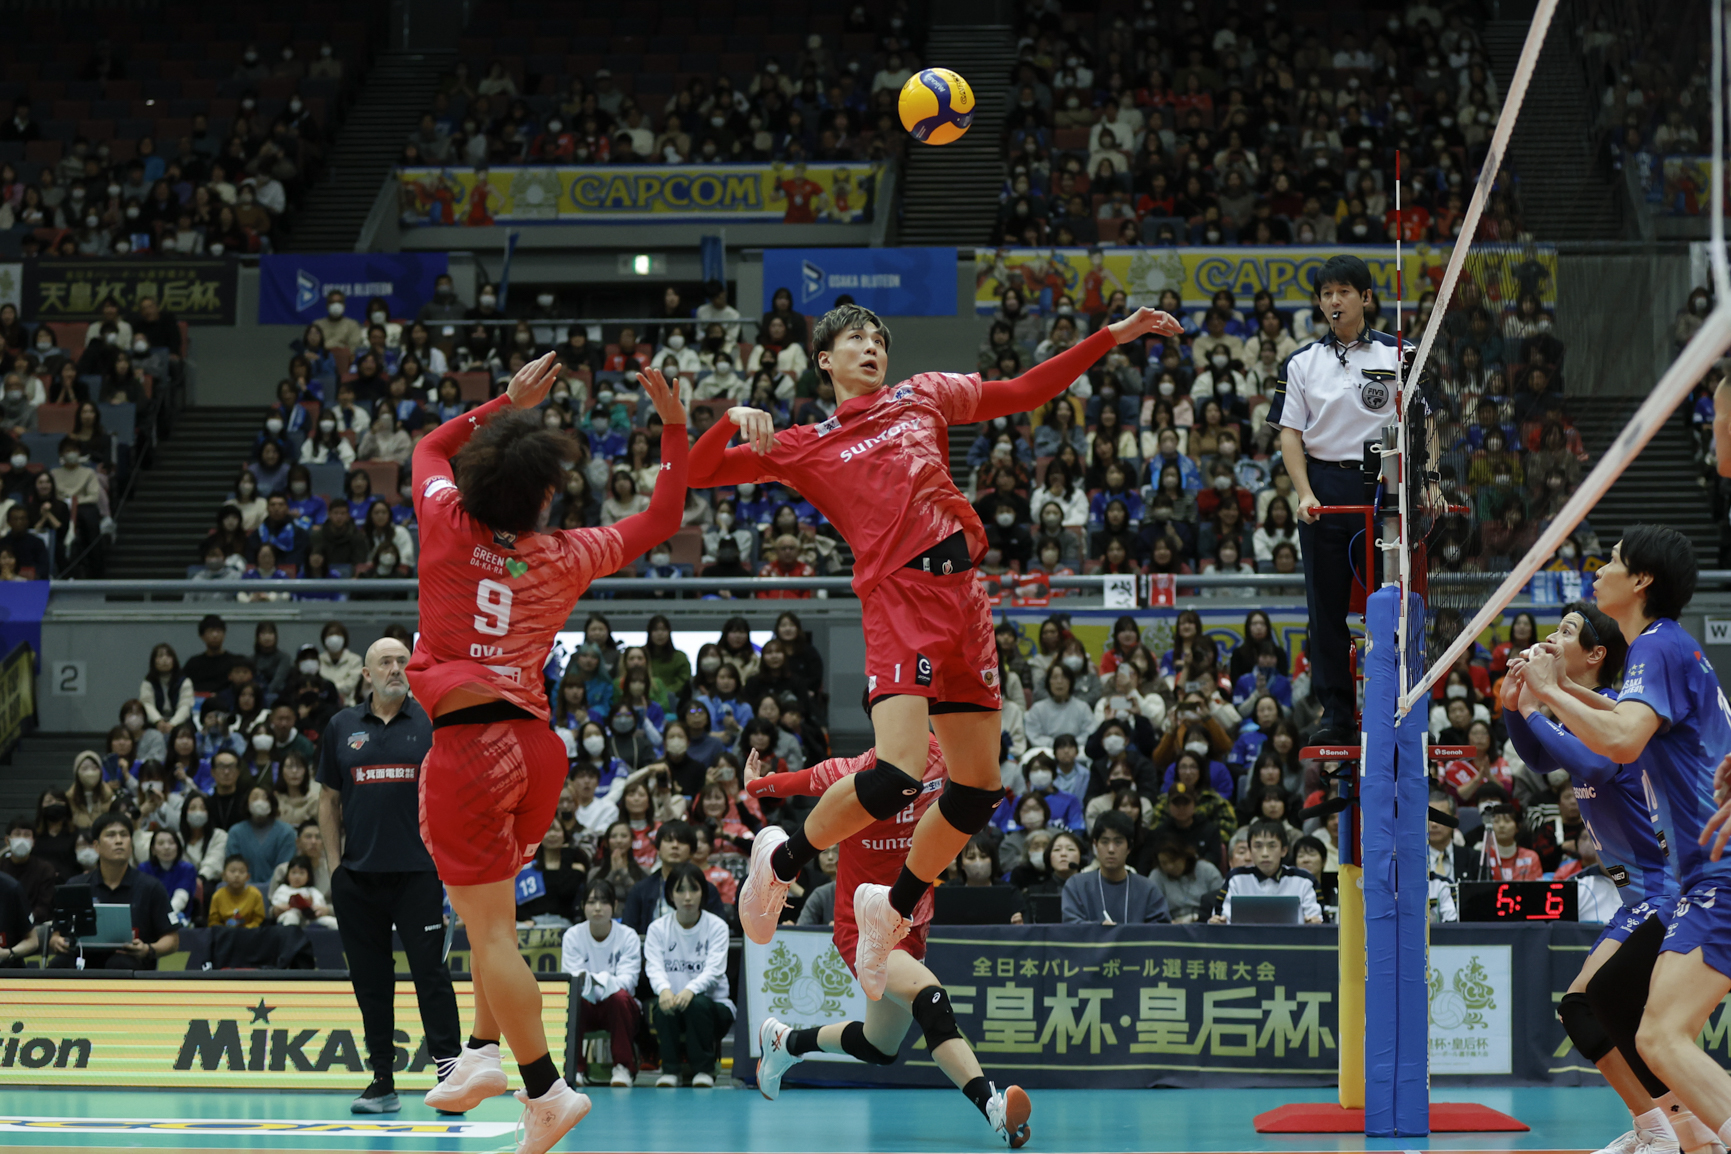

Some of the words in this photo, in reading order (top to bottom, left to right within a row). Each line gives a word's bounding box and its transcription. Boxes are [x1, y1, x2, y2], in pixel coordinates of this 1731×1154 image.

[571, 173, 762, 211] CAPCOM
[1194, 257, 1406, 299] CAPCM
[1367, 387, 1384, 396] FIVB
[473, 546, 505, 567] GREEN
[473, 578, 513, 637] 9
[1710, 625, 1728, 638] W
[60, 665, 78, 691] 2
[894, 663, 901, 683] 1
[519, 875, 538, 897] 13
[972, 957, 1277, 982] 全日本バレーボール選手権大会
[0, 1020, 93, 1069] ion
